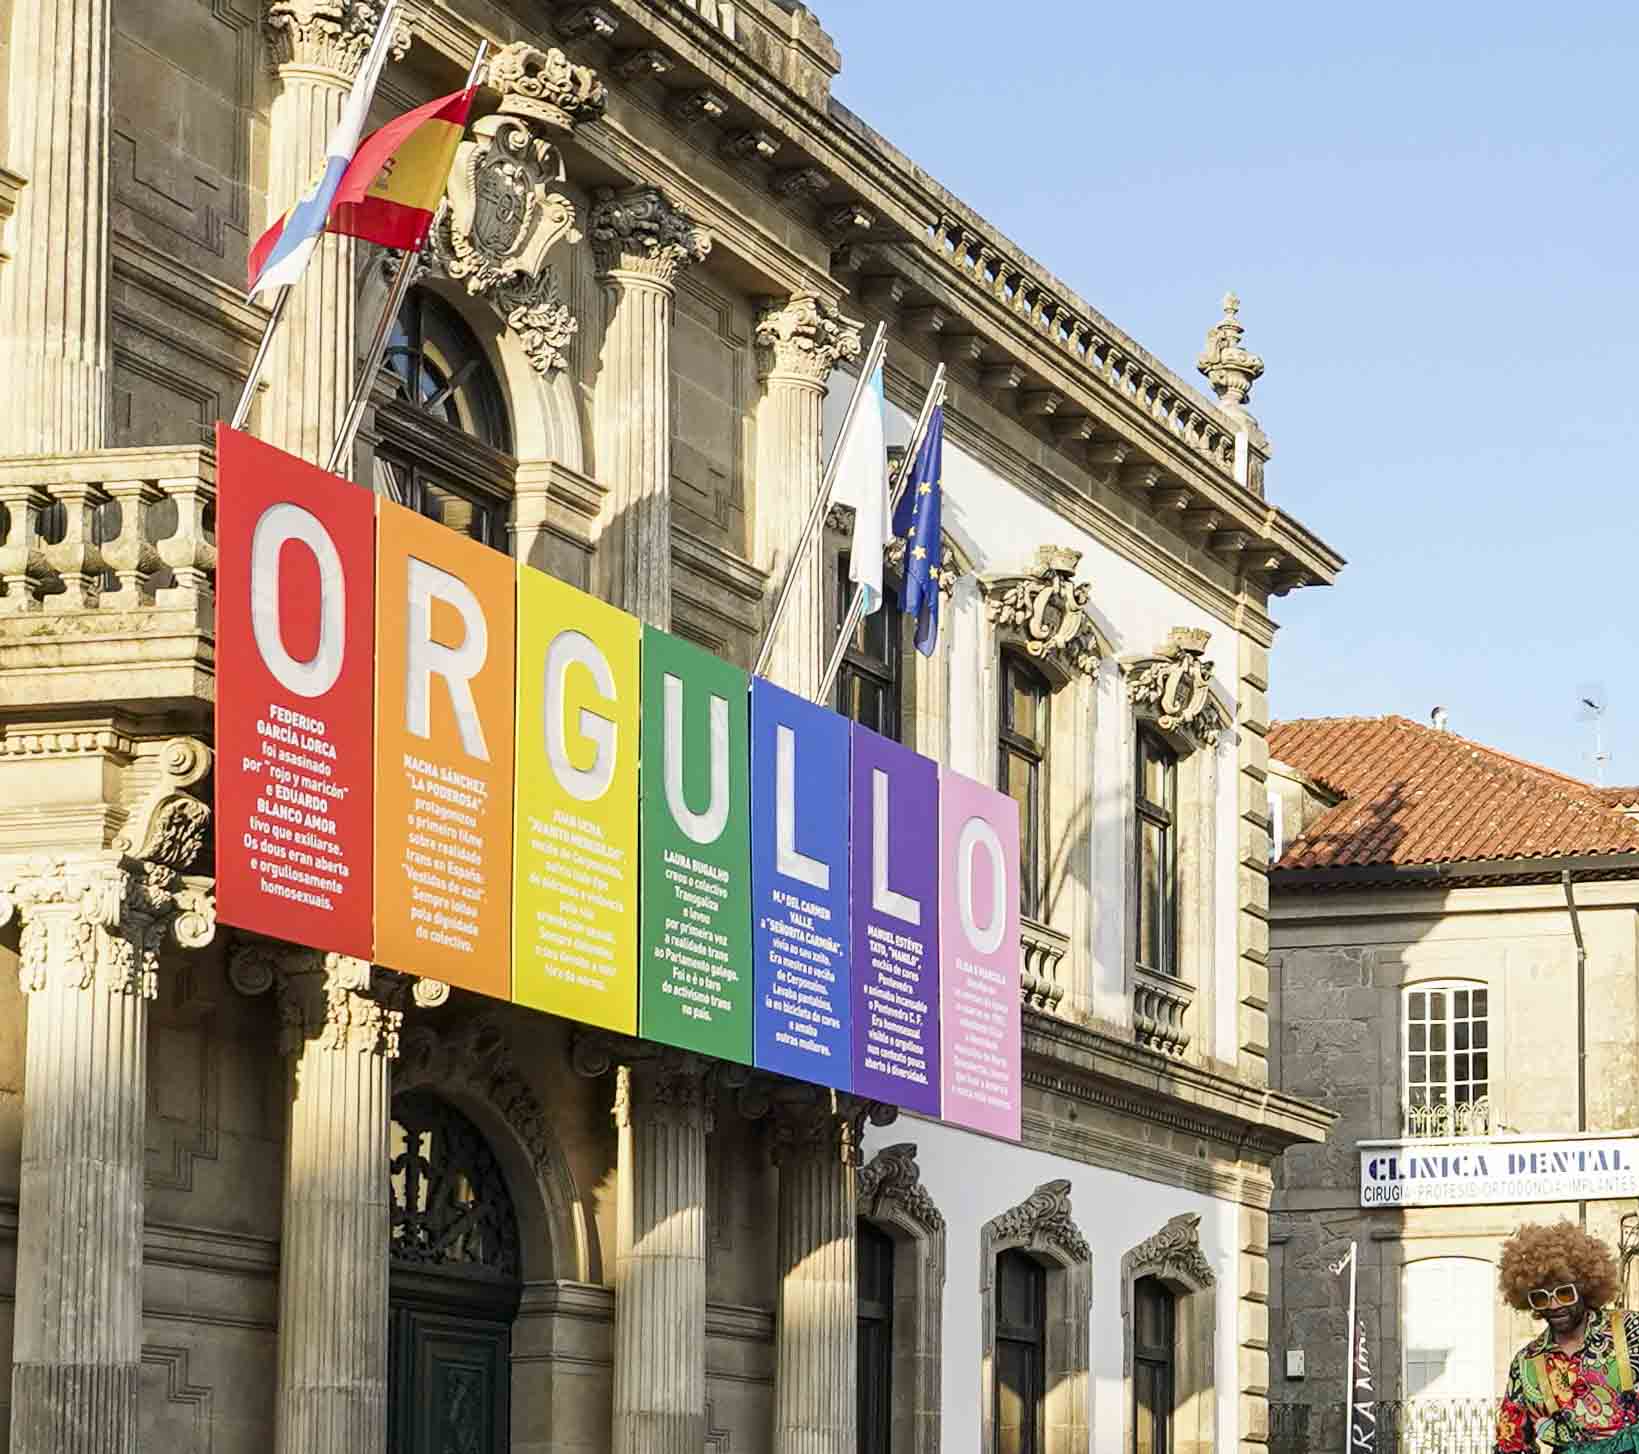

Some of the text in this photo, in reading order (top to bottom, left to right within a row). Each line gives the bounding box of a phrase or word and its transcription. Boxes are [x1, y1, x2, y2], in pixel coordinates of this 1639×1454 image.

[270, 703, 324, 736] FEDERICO
[256, 716, 336, 759] GARCÍA LORCA
[242, 755, 262, 775] por
[292, 772, 299, 787] y
[262, 740, 331, 777] foi asasinado
[266, 783, 327, 813] e EDUARDO
[249, 815, 269, 835] tivo
[272, 823, 292, 843] que
[257, 797, 335, 836] BLANCO AMOR
[243, 833, 258, 851] Os
[260, 838, 286, 858] dous
[288, 848, 312, 866] eran
[664, 848, 690, 870] LAURA
[251, 857, 342, 896] e orgullosamente
[1369, 1149, 1631, 1181] CLINICA DENTAL
